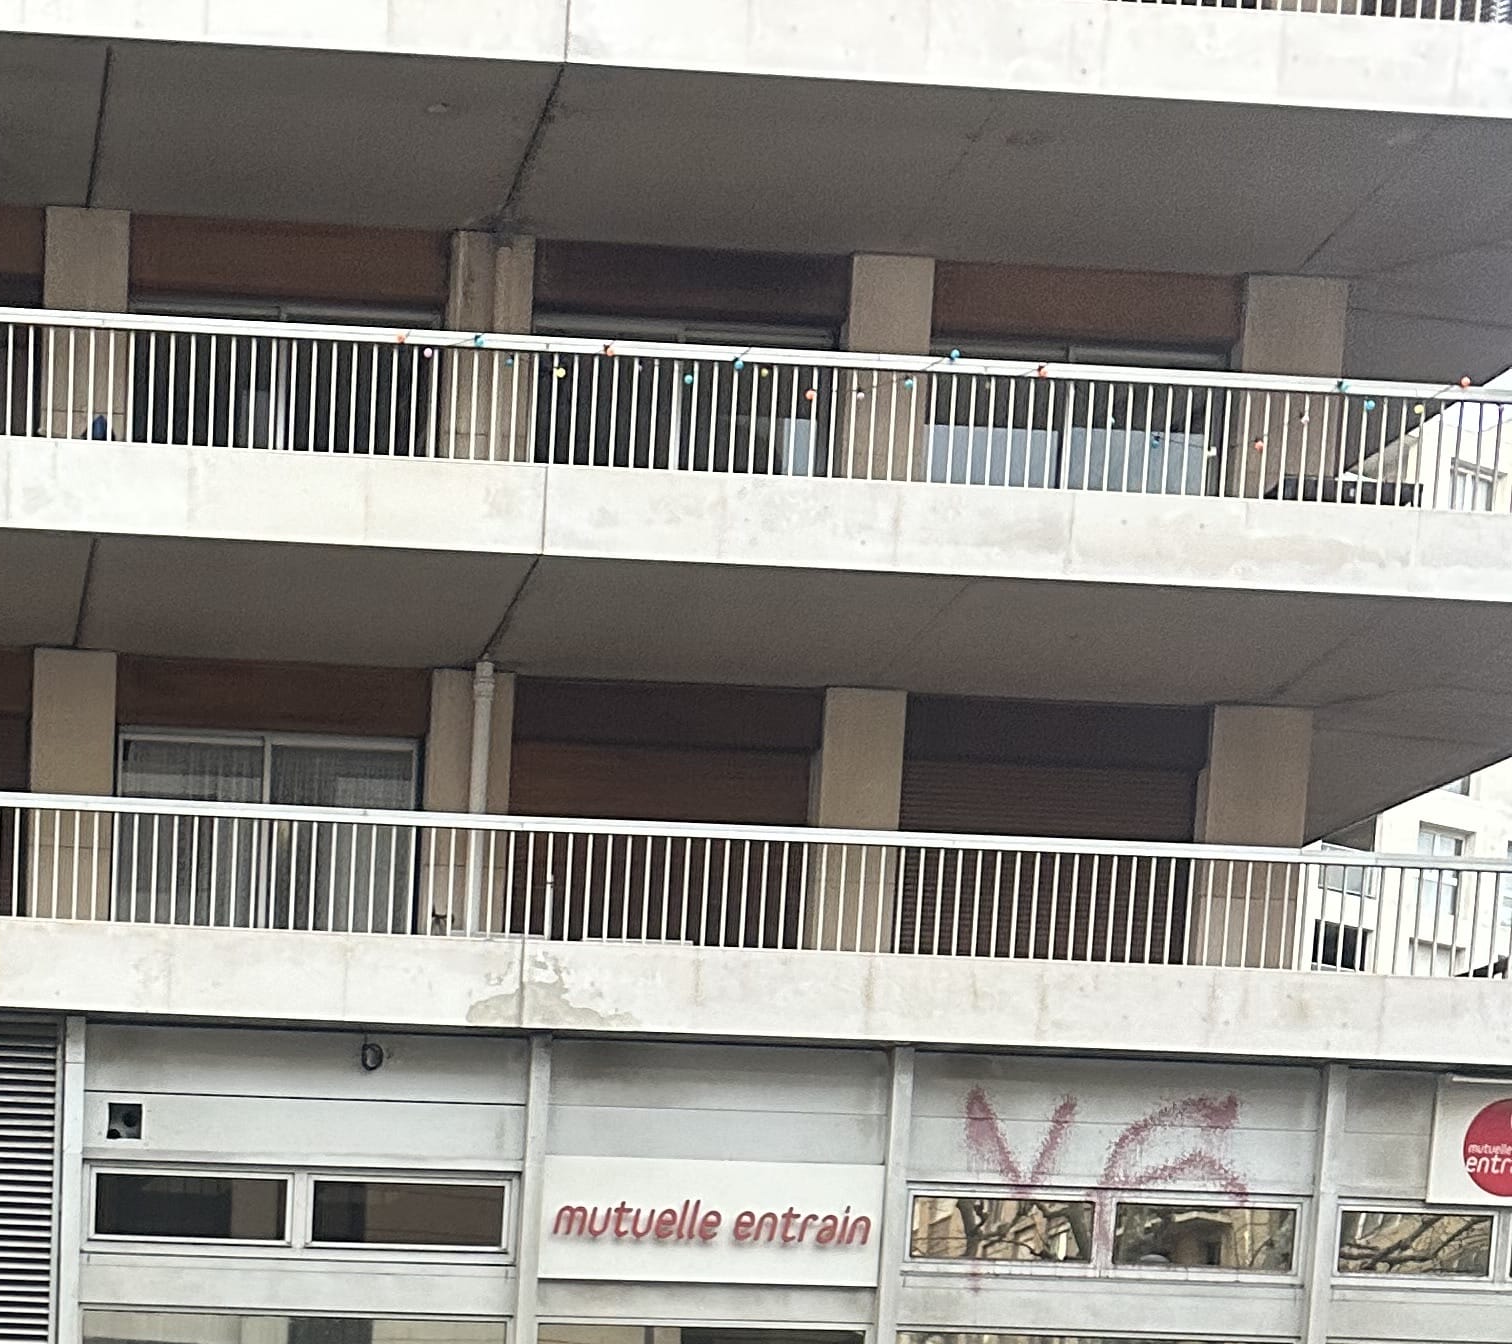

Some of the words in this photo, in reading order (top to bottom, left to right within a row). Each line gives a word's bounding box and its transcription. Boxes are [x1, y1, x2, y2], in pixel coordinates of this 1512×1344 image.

[1466, 1154, 1512, 1174] entr
[552, 1199, 723, 1241] mutuelle
[732, 1205, 872, 1246] entrain
